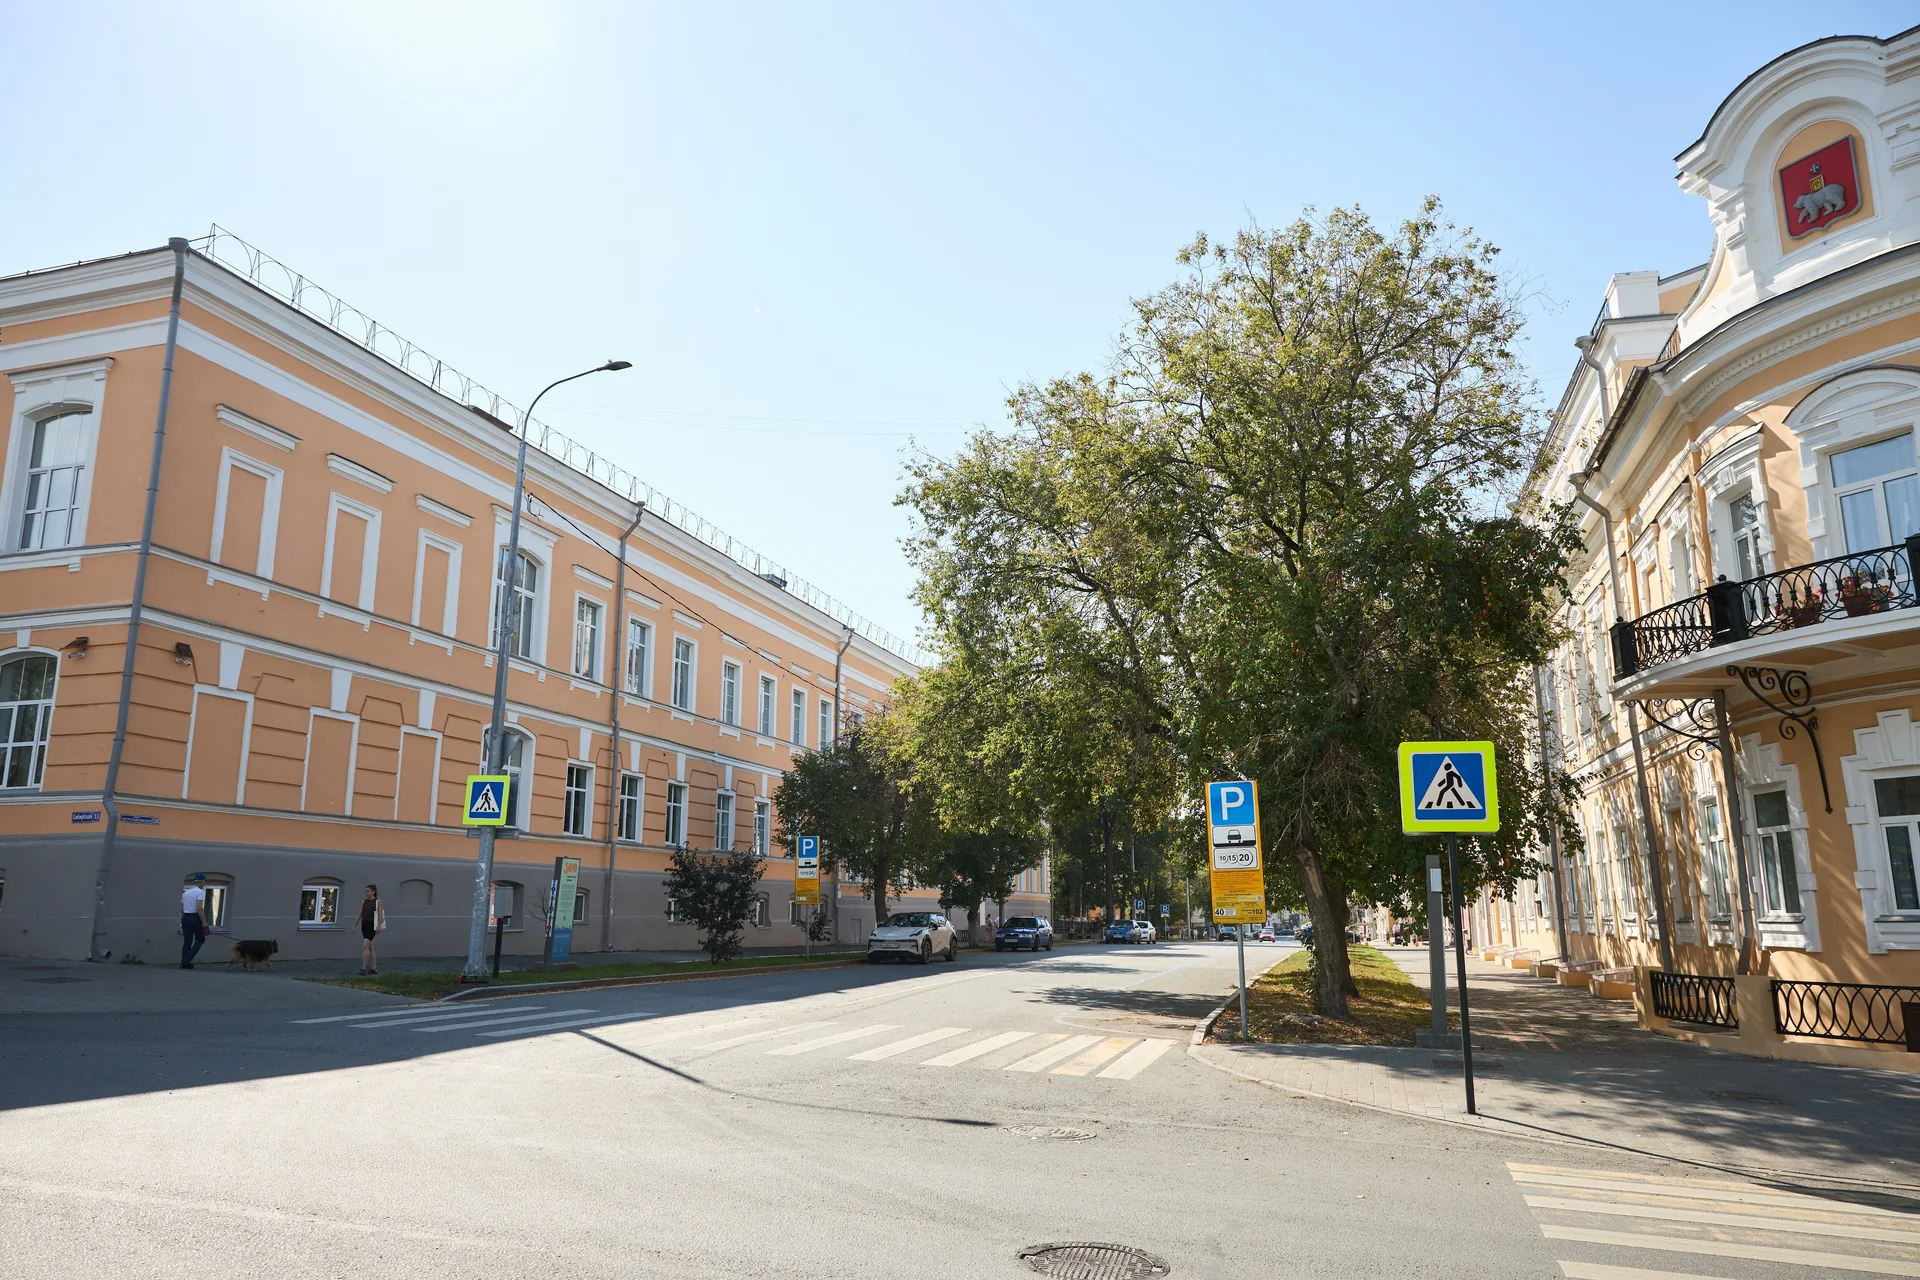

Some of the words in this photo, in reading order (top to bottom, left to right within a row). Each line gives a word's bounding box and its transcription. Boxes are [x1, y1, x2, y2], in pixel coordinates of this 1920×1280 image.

[1221, 787, 1244, 820] P
[72, 813, 93, 821] Сибирская
[803, 839, 814, 855] P
[1239, 853, 1249, 861] 20
